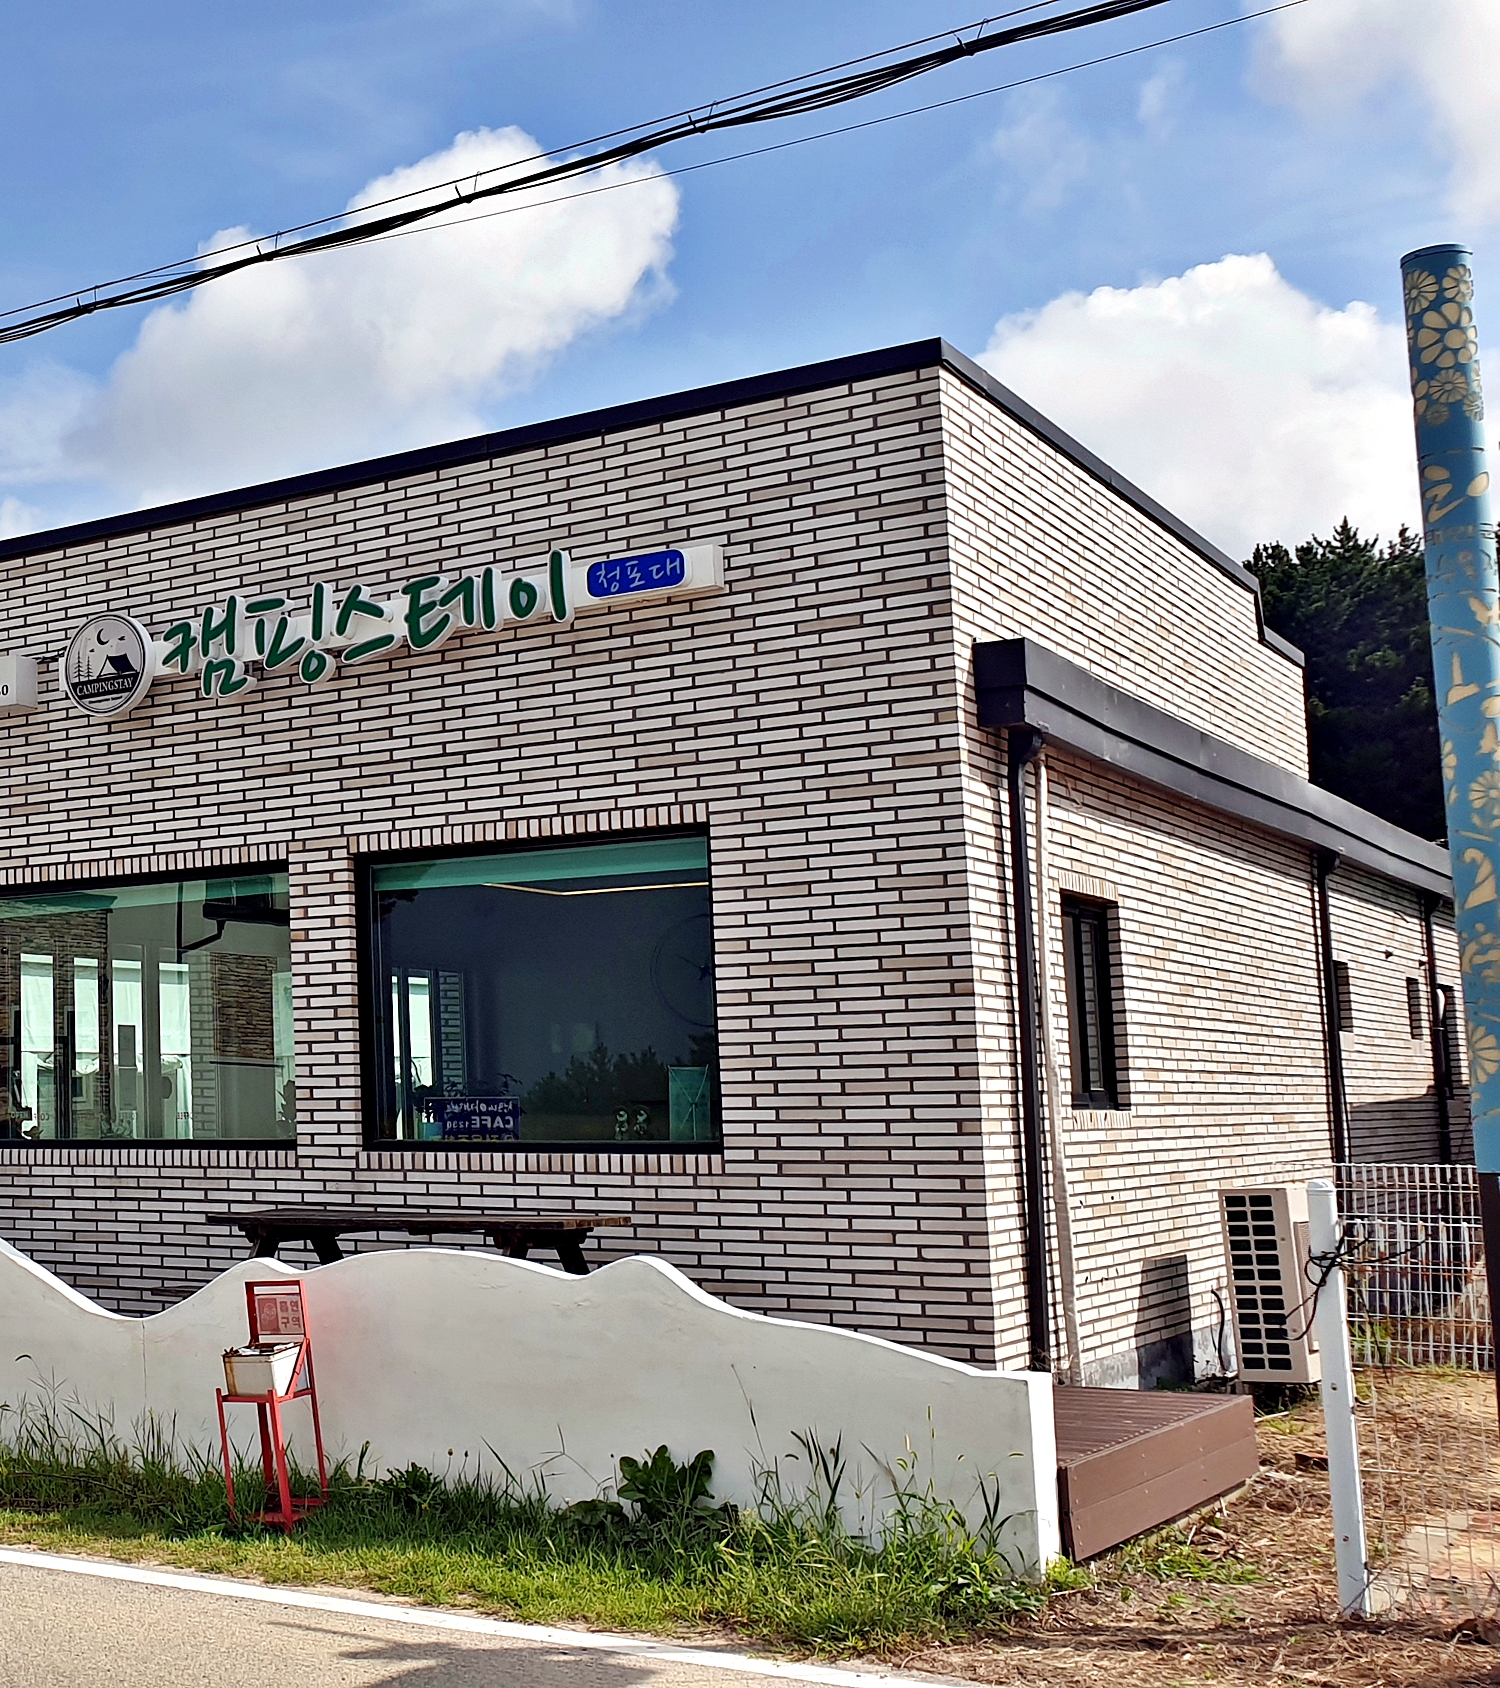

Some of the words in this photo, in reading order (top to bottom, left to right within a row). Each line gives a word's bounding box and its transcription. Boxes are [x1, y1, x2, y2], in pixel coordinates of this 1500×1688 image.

[596, 557, 683, 595] 청포대
[161, 549, 570, 698] 캠핑스테이
[76, 677, 134, 696] CAMPINGSTAY
[281, 1316, 301, 1328] 구역
